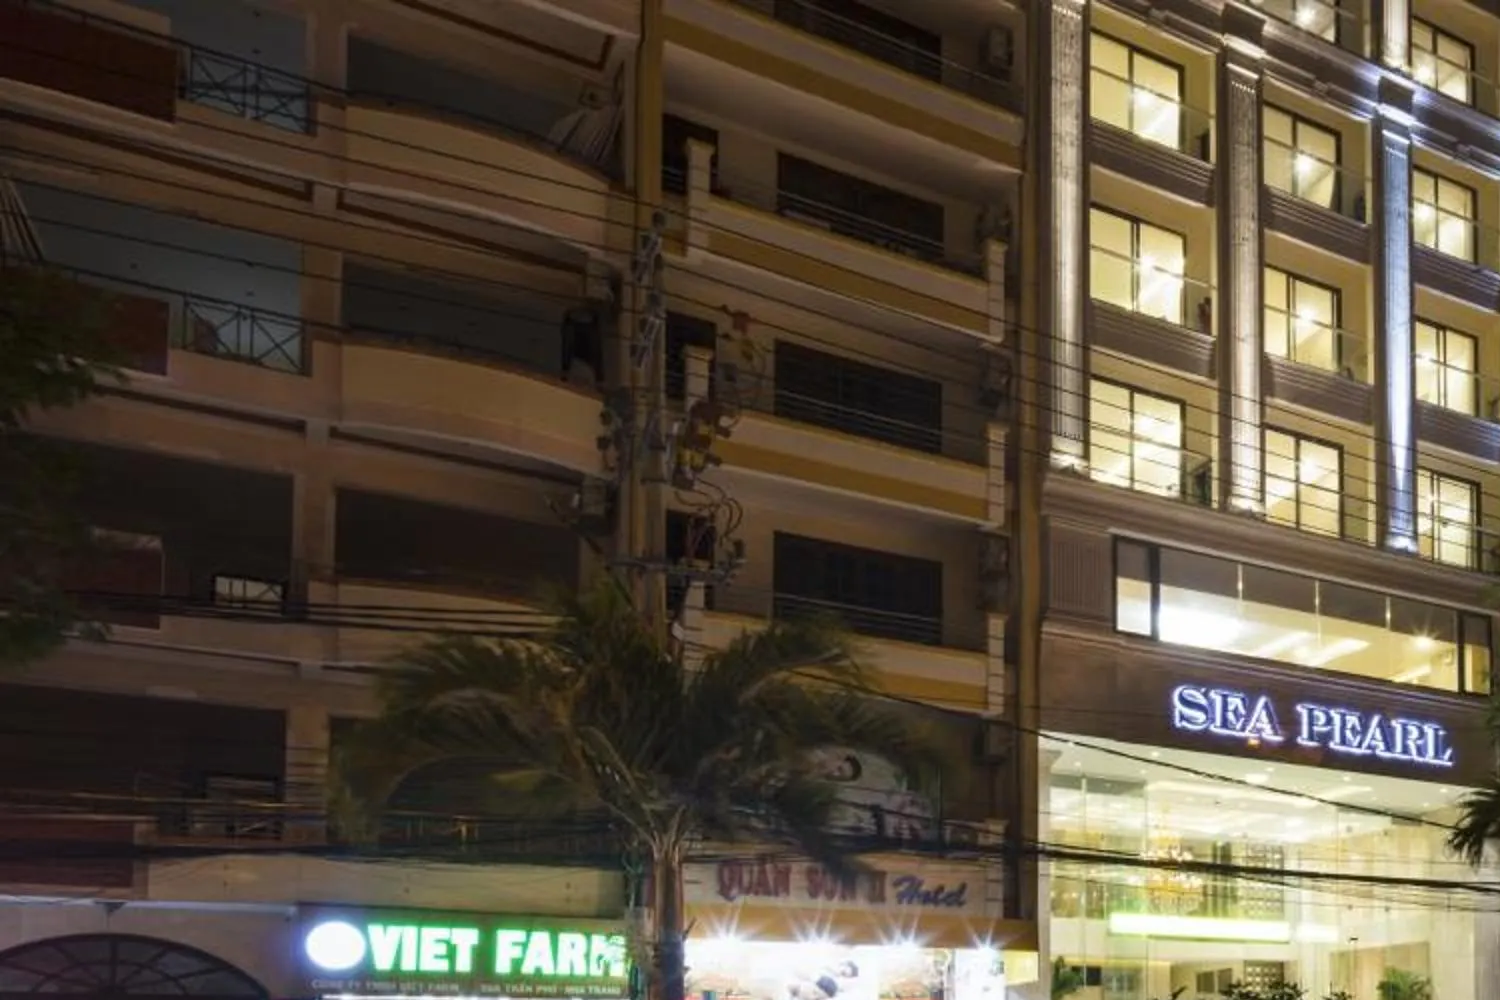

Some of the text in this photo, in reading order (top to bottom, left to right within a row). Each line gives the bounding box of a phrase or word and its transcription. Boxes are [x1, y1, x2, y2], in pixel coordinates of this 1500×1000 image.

[1172, 683, 1454, 766] SEA PEARL
[366, 923, 627, 978] VIET FARM
